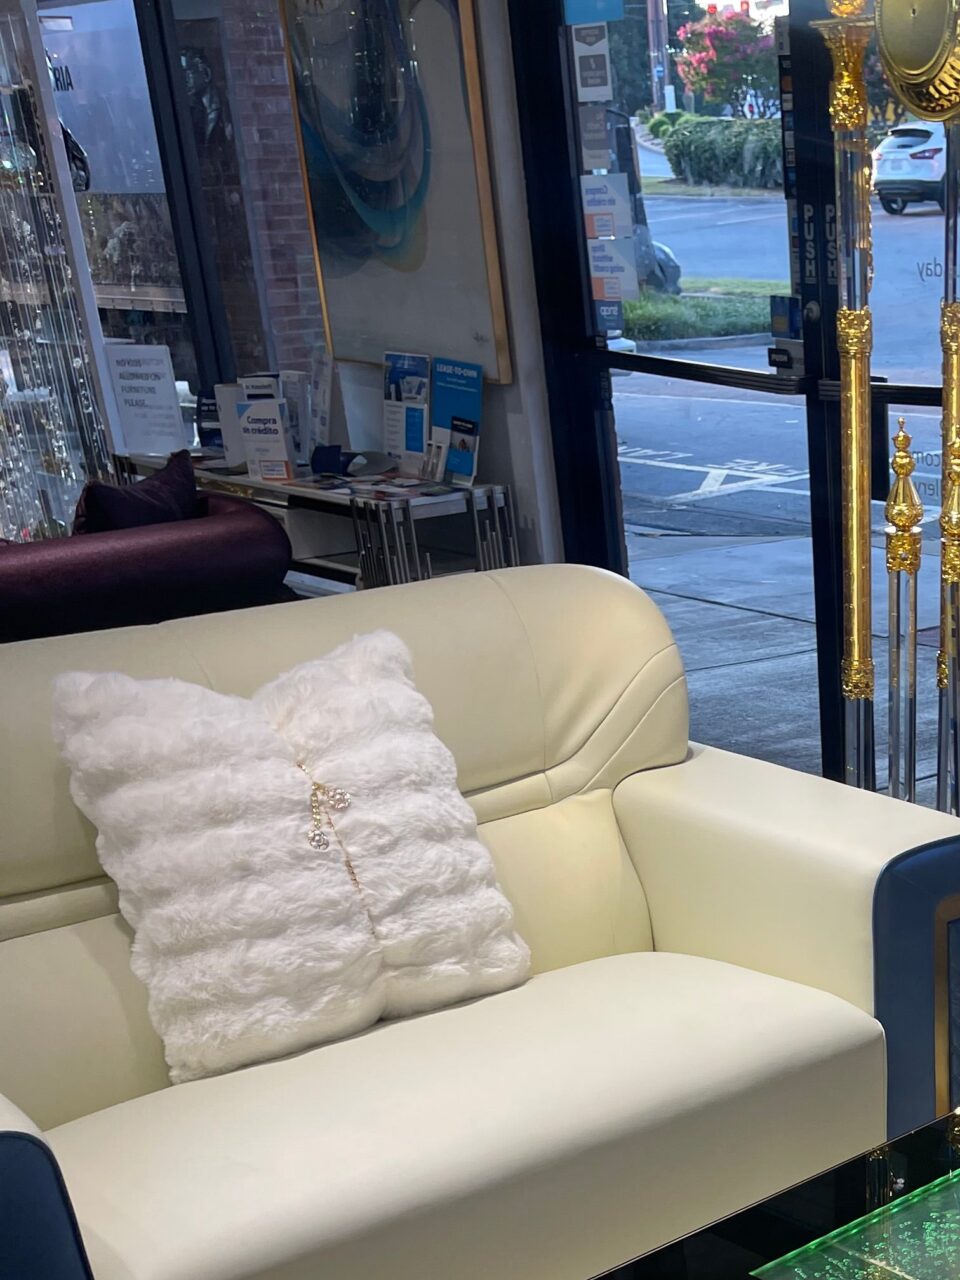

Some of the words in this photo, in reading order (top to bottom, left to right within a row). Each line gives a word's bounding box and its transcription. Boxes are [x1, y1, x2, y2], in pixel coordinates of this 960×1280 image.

[53, 65, 74, 92] RIA
[803, 205, 817, 277] PUSH
[825, 204, 839, 277] PUSH
[246, 415, 277, 429] Compra
